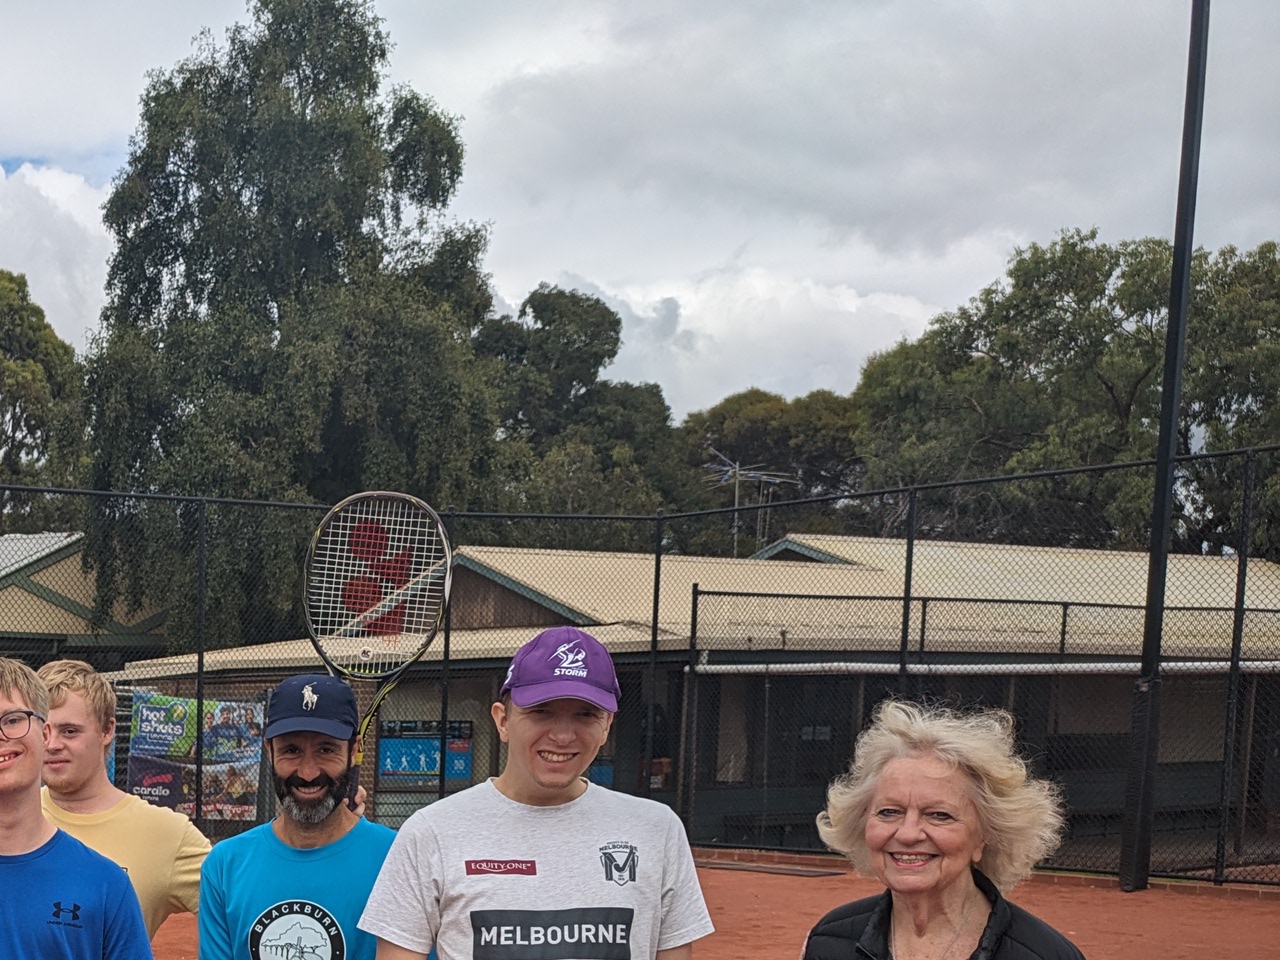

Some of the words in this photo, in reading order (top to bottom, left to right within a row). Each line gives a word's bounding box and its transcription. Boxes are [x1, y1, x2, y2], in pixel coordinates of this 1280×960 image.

[553, 668, 588, 678] STORM
[141, 707, 166, 721] hot
[141, 721, 183, 734] shots
[132, 785, 170, 797] cardio
[255, 903, 338, 936] BLACKBURN
[481, 924, 627, 946] MELBOURNE
